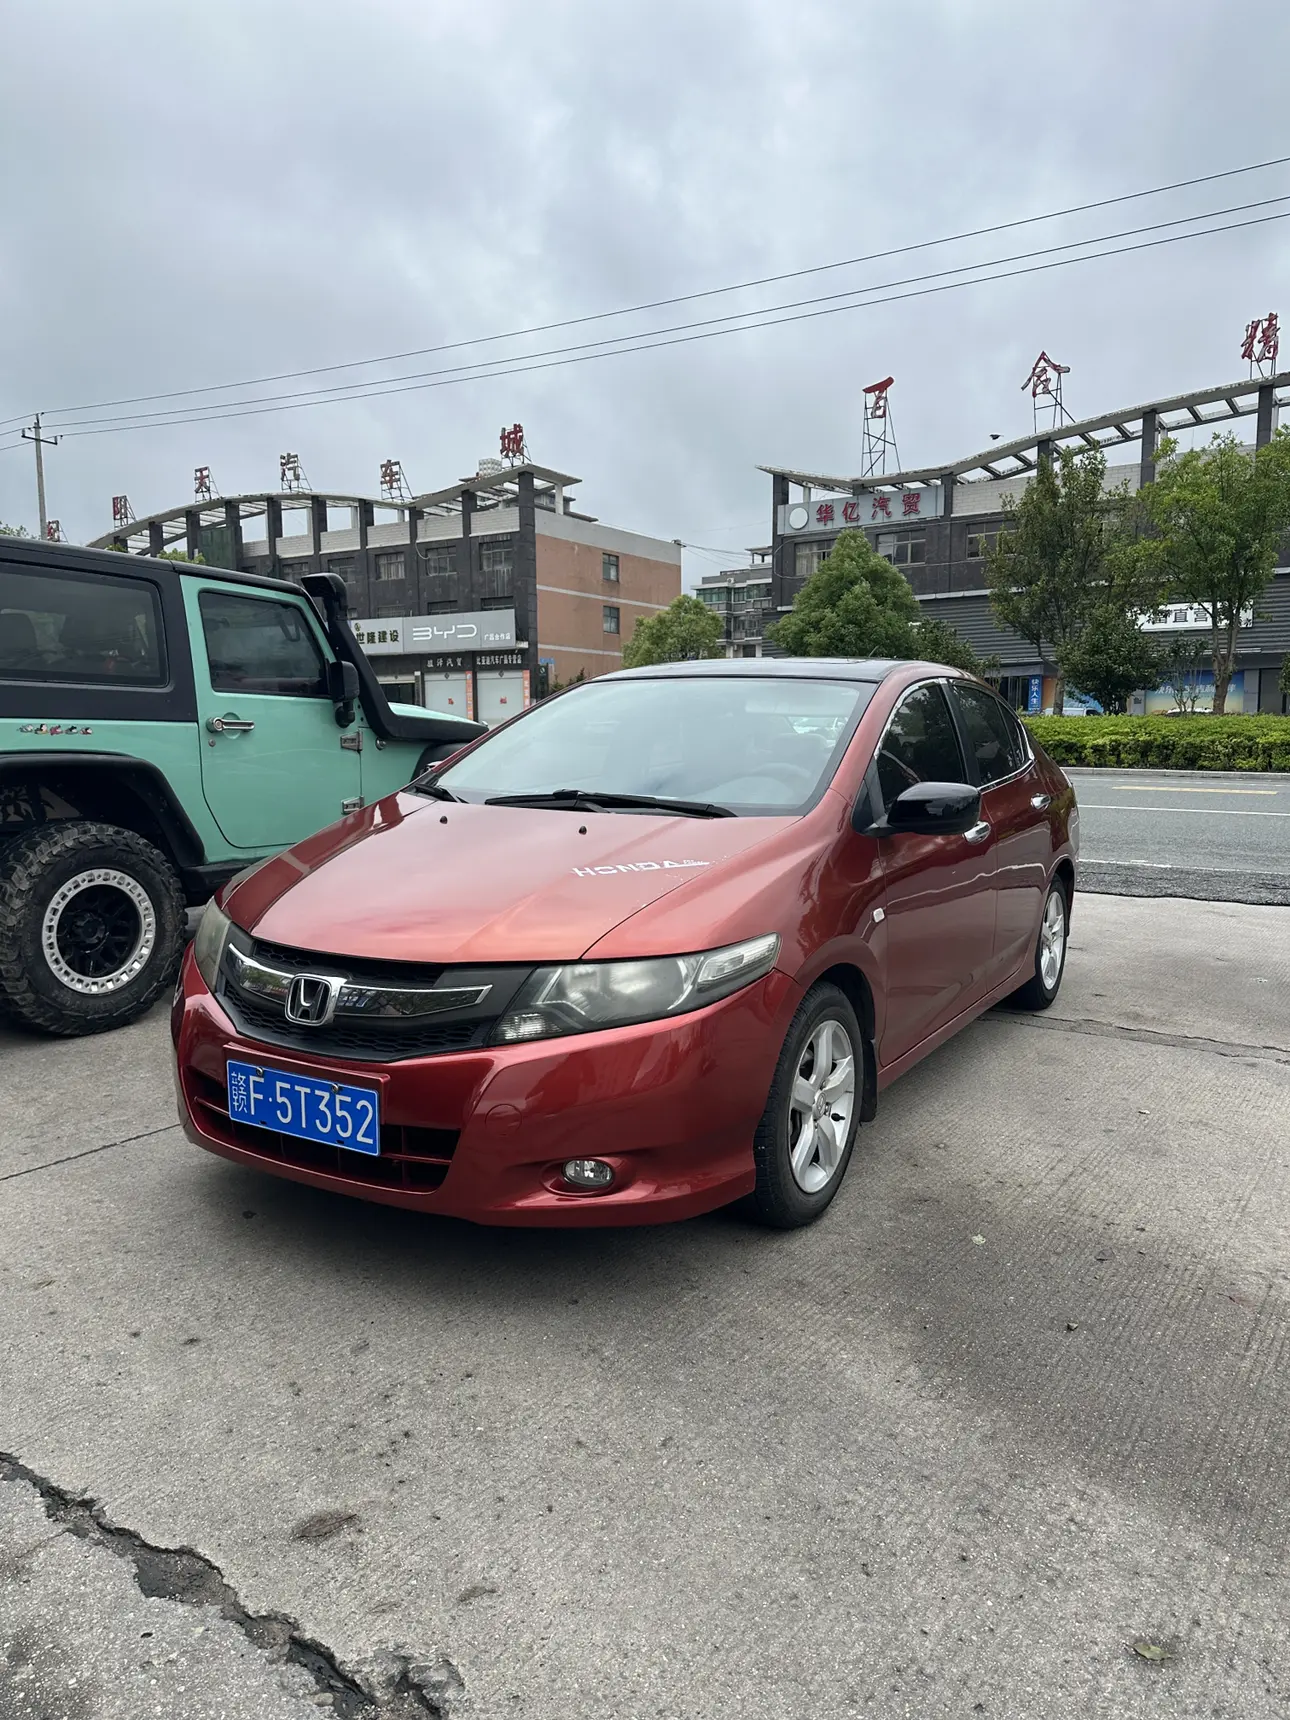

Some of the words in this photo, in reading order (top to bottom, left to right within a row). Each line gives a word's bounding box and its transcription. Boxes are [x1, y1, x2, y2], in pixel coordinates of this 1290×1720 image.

[816, 493, 921, 525] 华亿汽贸
[356, 630, 399, 645] 世隆建设
[412, 624, 477, 641] BYD
[571, 859, 682, 877] HONDA
